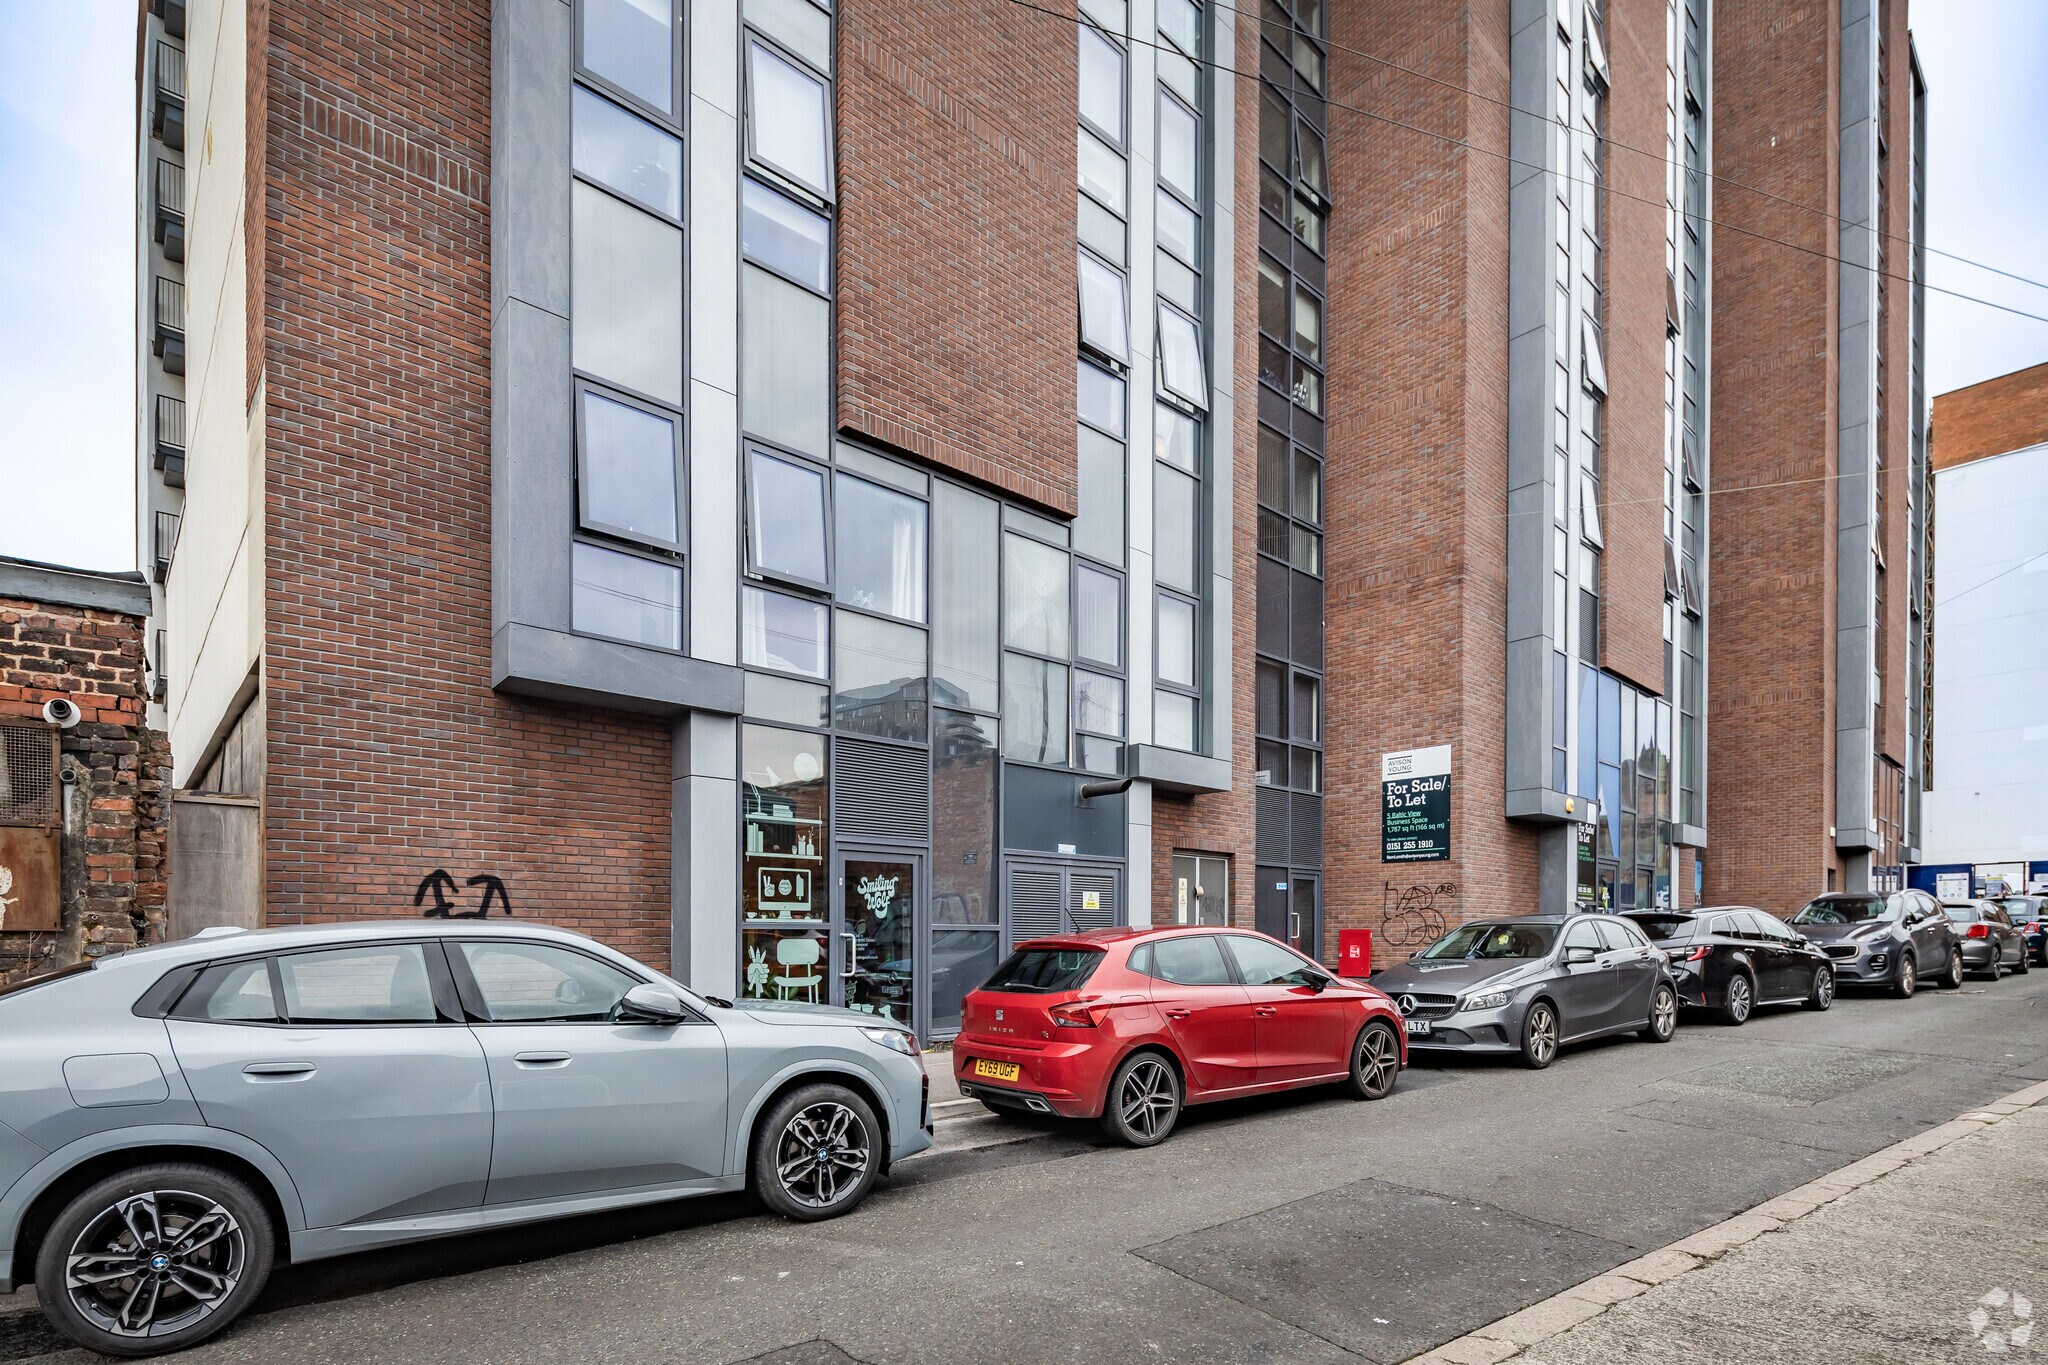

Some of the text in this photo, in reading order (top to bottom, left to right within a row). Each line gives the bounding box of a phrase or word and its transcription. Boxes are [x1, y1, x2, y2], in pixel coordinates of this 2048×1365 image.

[1388, 758, 1412, 766] AVISON
[1388, 765, 1412, 773] YOUNG
[1387, 776, 1447, 795] For Sale/
[1387, 793, 1426, 808] To Let
[1391, 811, 1407, 819] Baltic
[1387, 817, 1428, 826] Business Space
[1436, 822, 1445, 830] m)
[1387, 840, 1433, 851] 0151 255 1910
[857, 874, 899, 898] Smiling
[864, 891, 891, 919] Wolf
[989, 1026, 1015, 1034] IBIZA
[1407, 1021, 1426, 1031] LTX
[978, 1060, 1017, 1077] EY69 UGF
